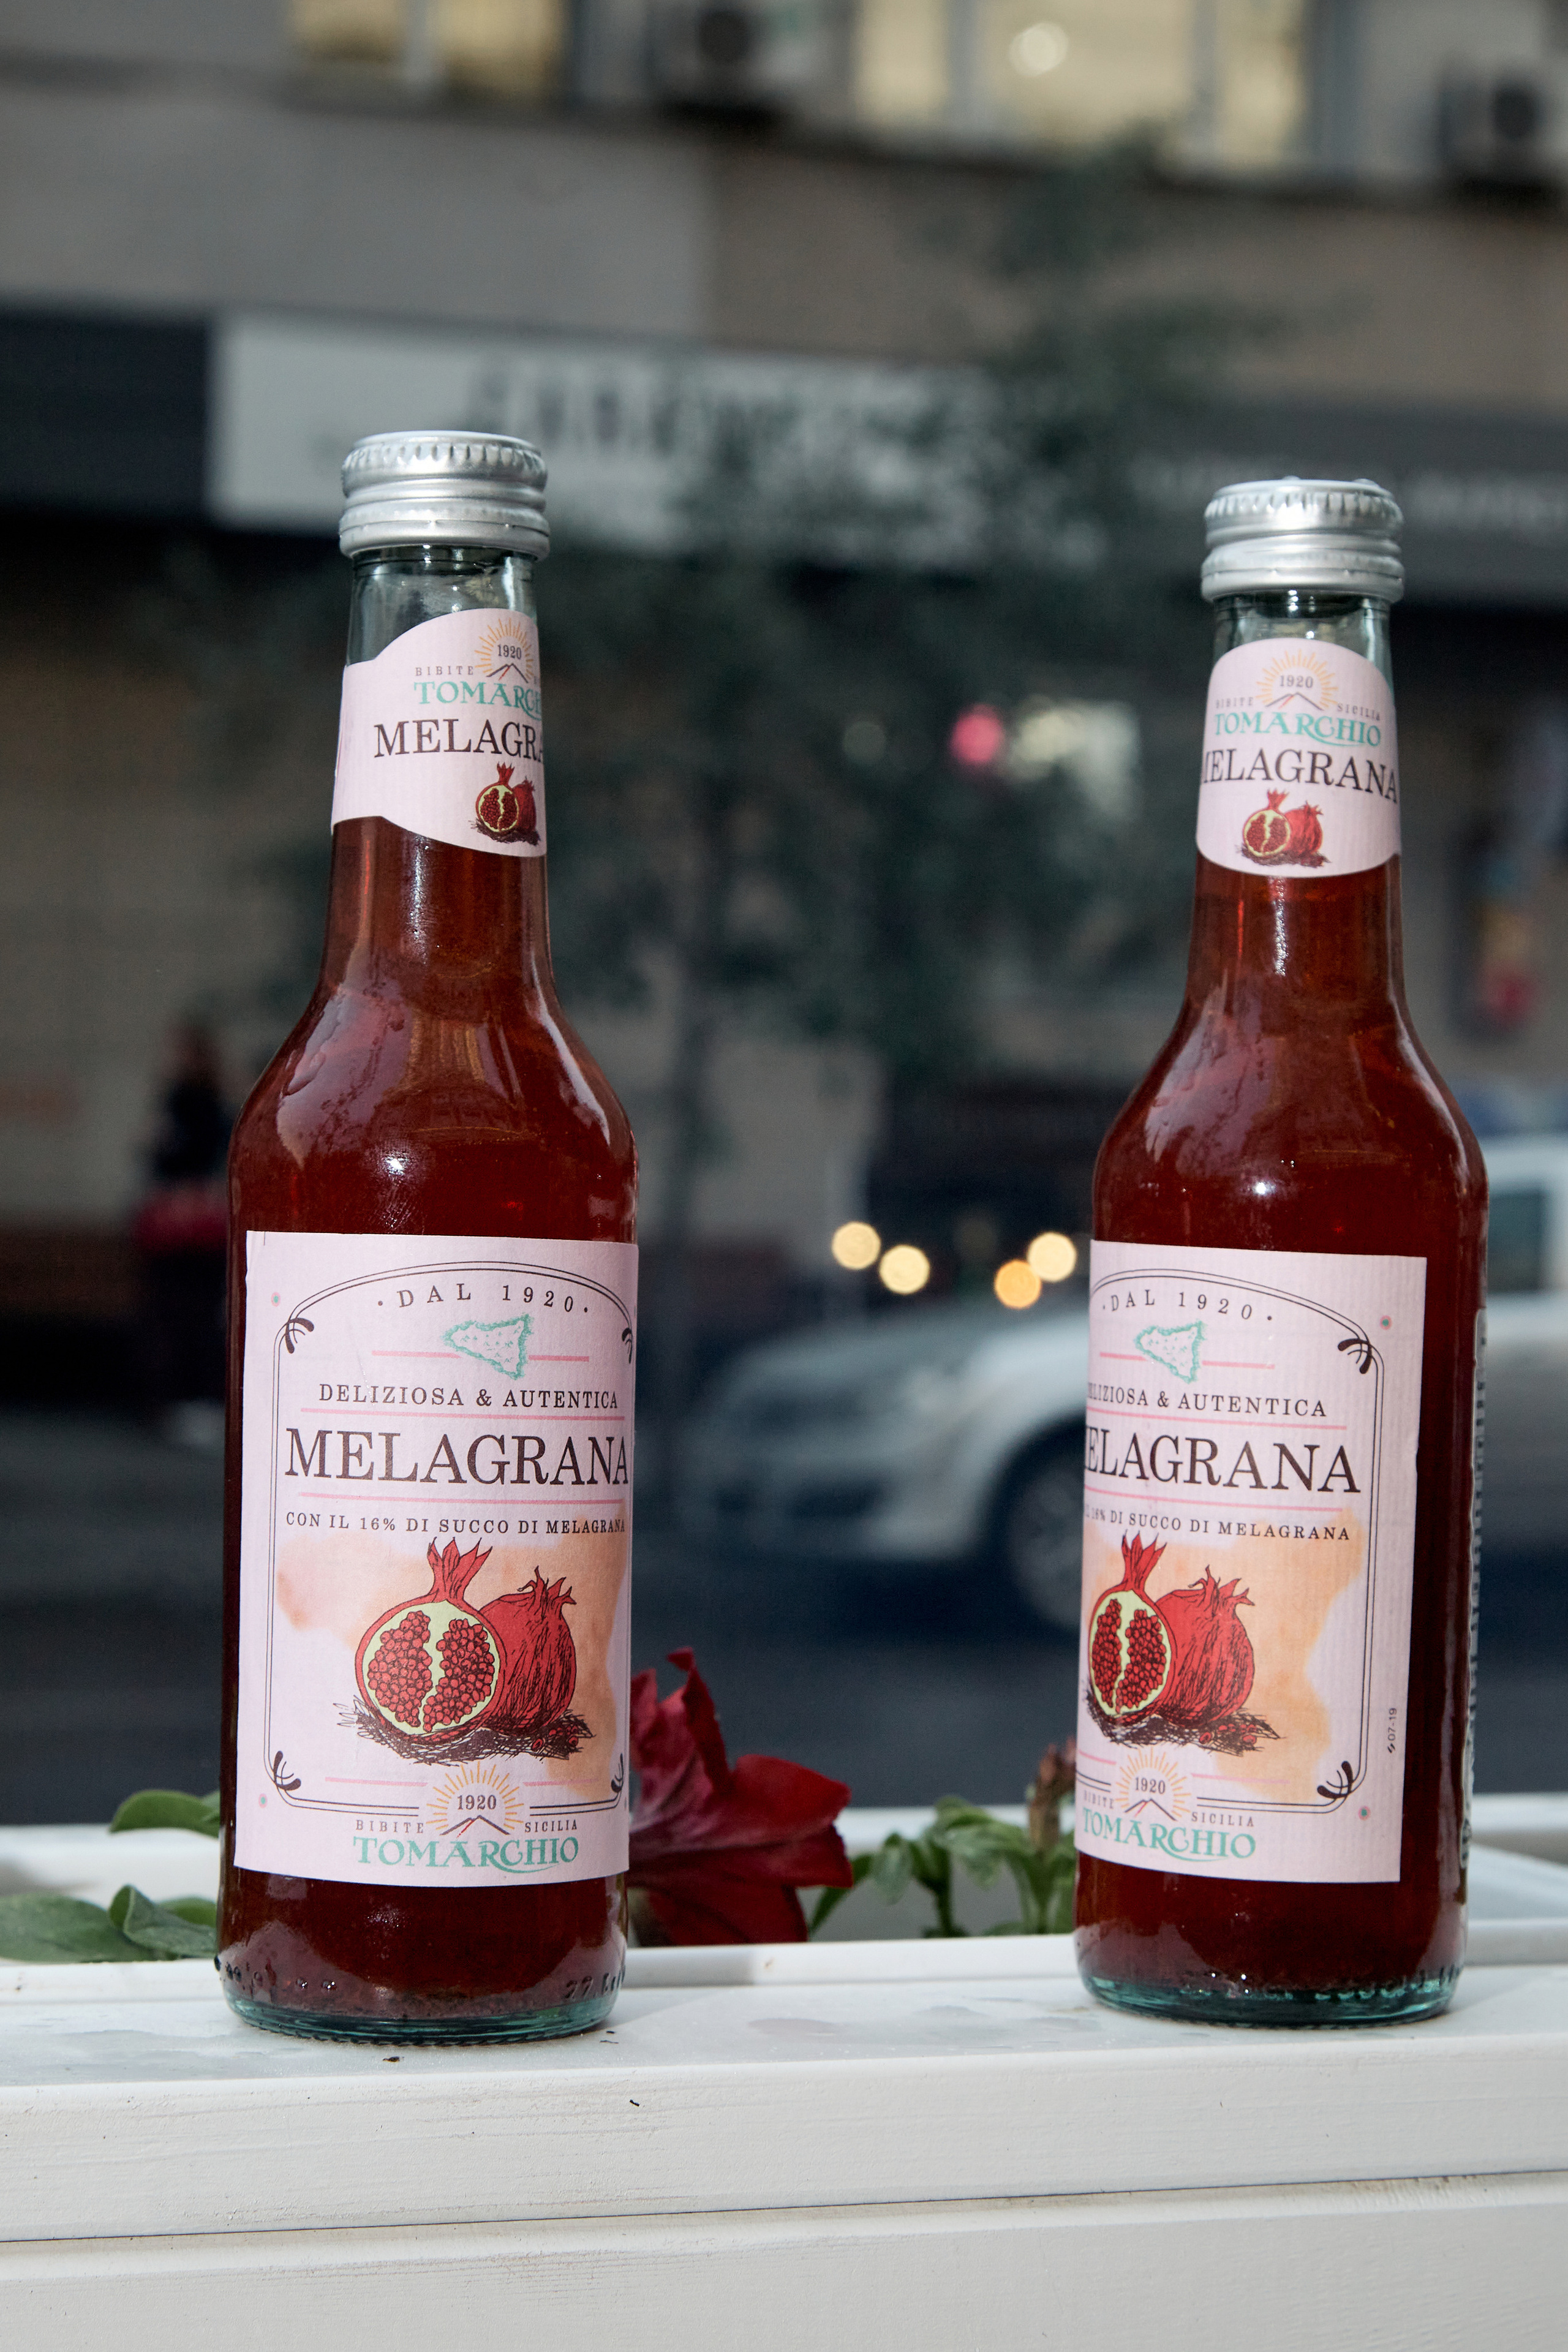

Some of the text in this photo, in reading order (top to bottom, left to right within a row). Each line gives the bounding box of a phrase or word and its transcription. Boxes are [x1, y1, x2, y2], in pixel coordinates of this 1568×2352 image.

[497, 644, 522, 660] 1920
[415, 665, 474, 677] BIBITE
[1279, 674, 1314, 689] 1920
[1337, 703, 1381, 721] SICILIA
[374, 718, 543, 763] MELAGR
[1216, 712, 1380, 746] TOMARCHIO
[397, 1283, 574, 1313] DAL 1920
[1111, 1289, 1253, 1319] DAL 1920
[319, 1384, 617, 1408] DELIZIOSA & AUTENTICA
[1088, 1382, 1326, 1417] ELIZIOSA & AUTENTICA
[285, 1428, 628, 1485] MELAGRANA
[1085, 1425, 1361, 1493] ELAGRANA
[287, 1512, 625, 1534] CON IL 16% DI SUCCO DI MELAGRANA
[1110, 1510, 1122, 1524] DI
[1129, 1513, 1182, 1530] SUCCO
[1190, 1520, 1208, 1533] DI
[1218, 1521, 1350, 1541] MELAGRANA
[1135, 1776, 1166, 1795] 1920
[456, 1793, 497, 1811] 1920
[355, 1819, 578, 1834] BIBITE SICILIA
[1191, 1811, 1256, 1828] SICILIA
[1083, 1807, 1256, 1862] TOMARCHIO
[353, 1836, 578, 1873] TOMARCHIO
